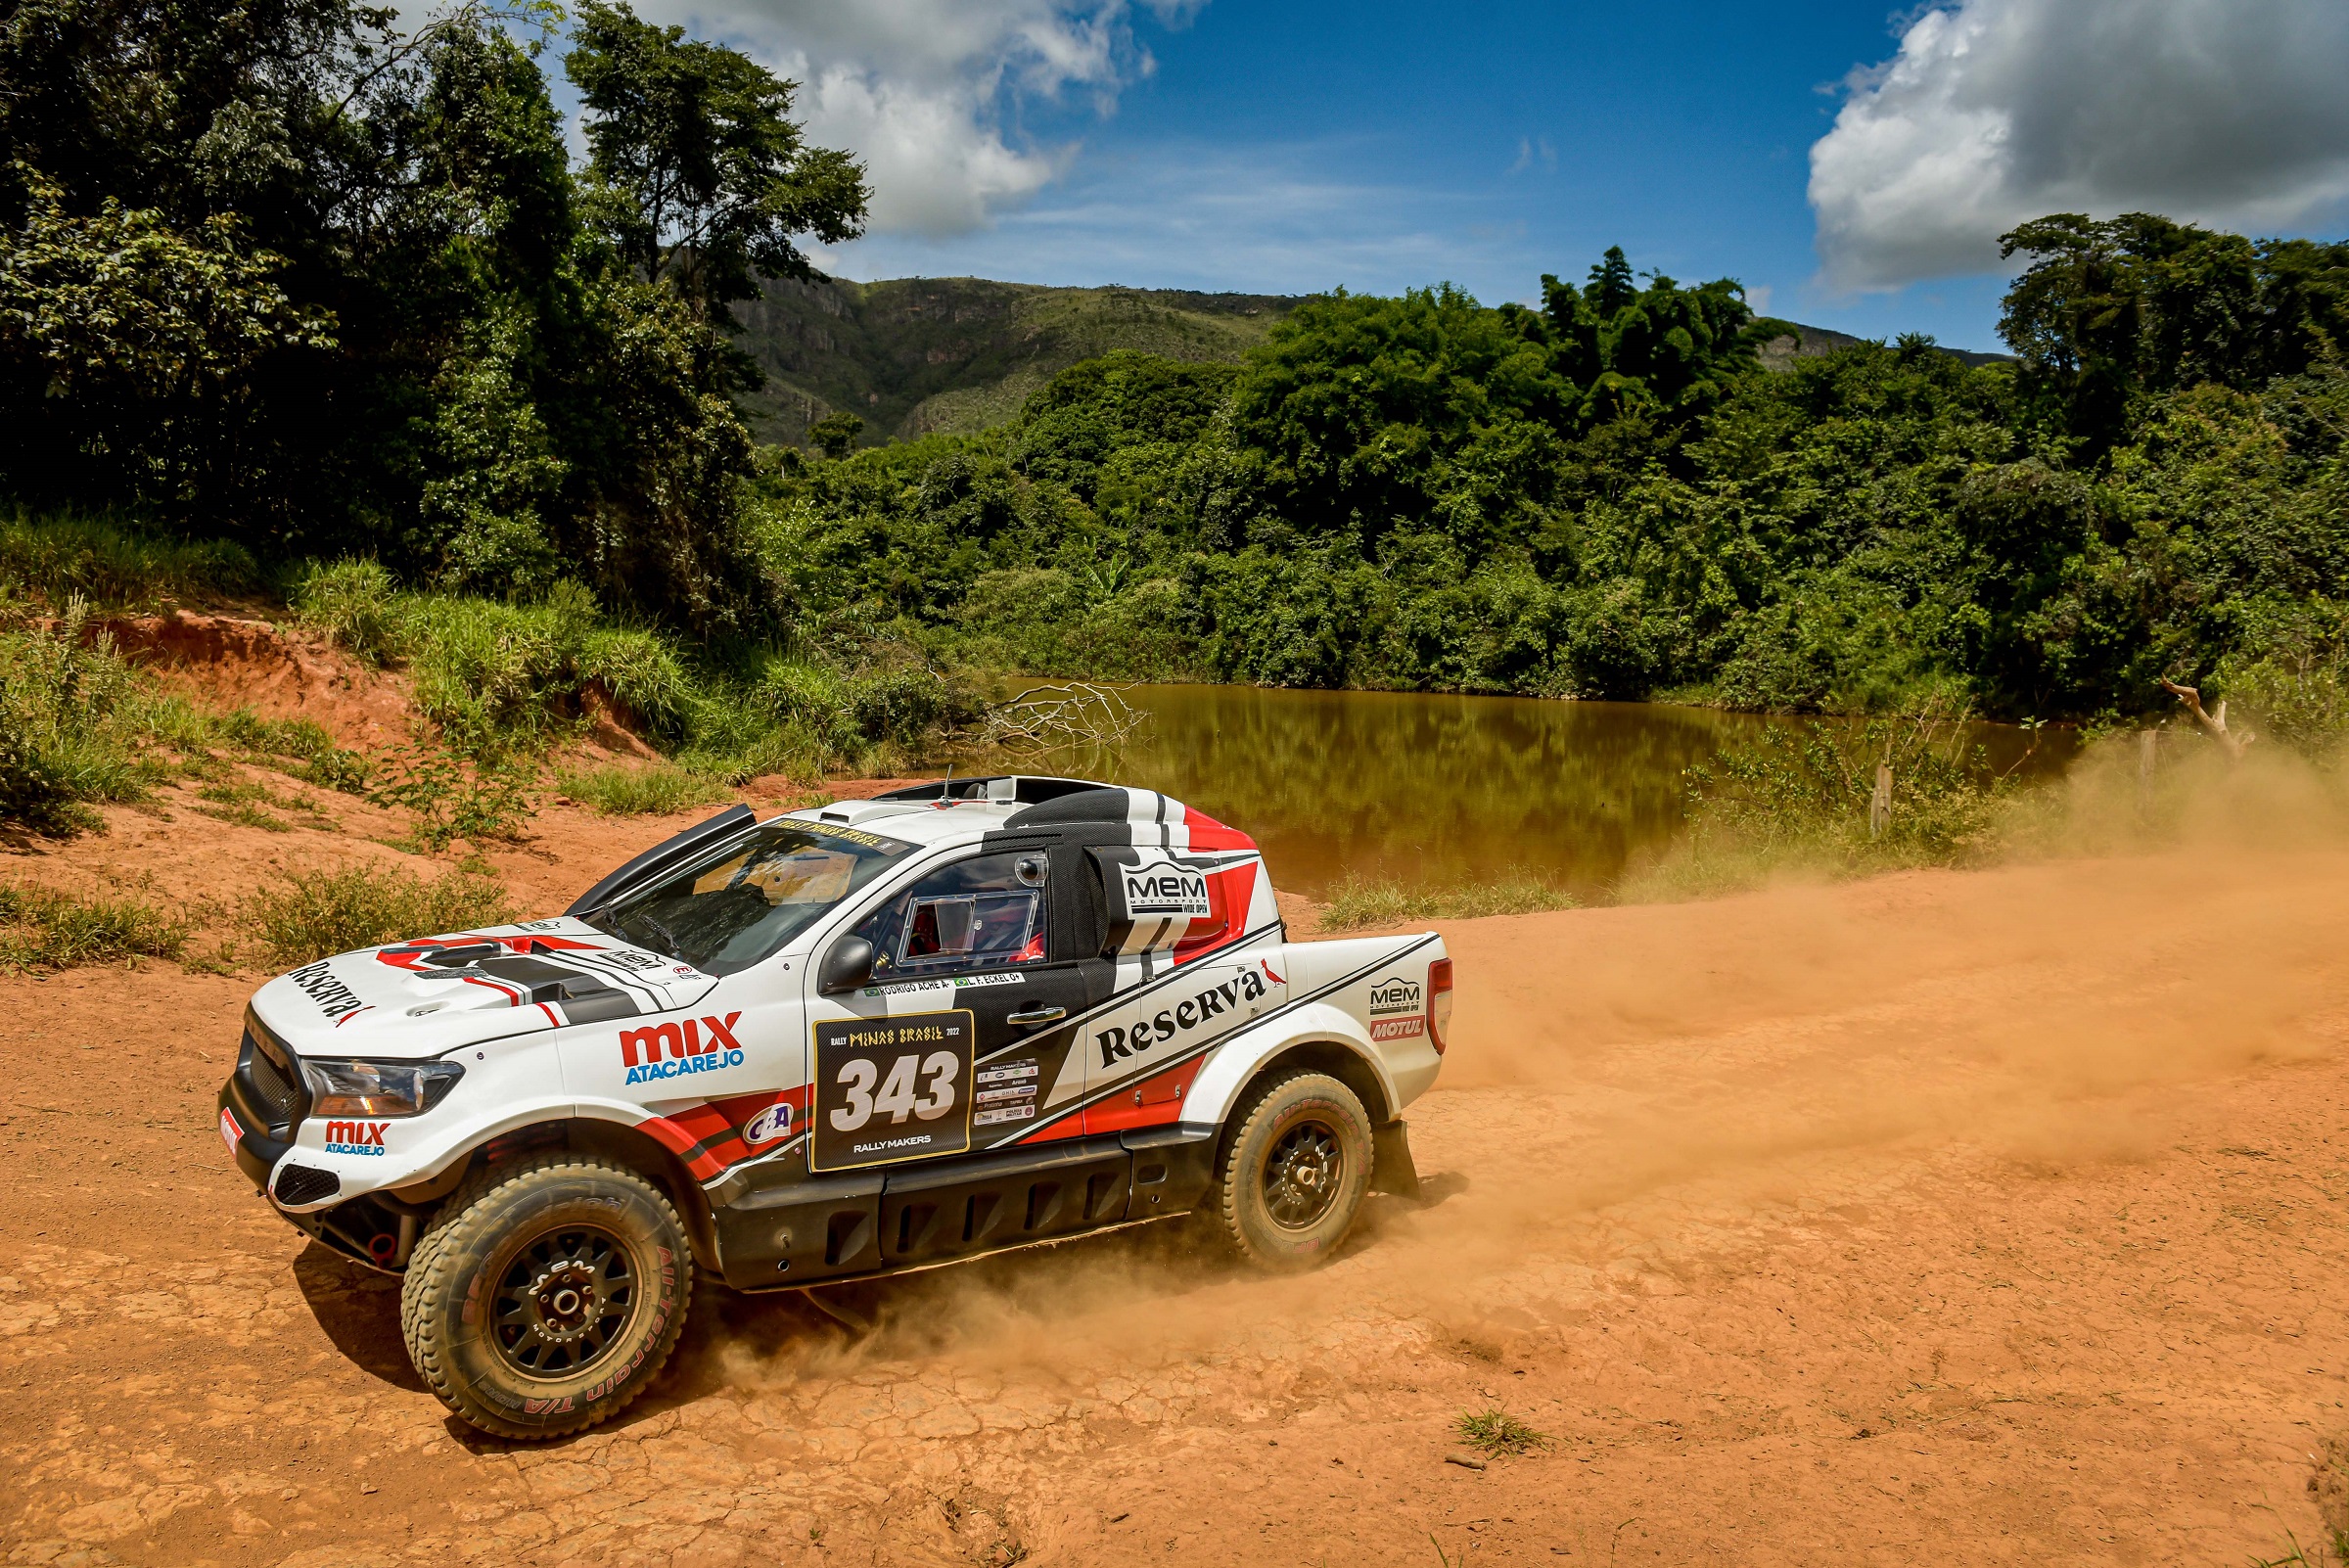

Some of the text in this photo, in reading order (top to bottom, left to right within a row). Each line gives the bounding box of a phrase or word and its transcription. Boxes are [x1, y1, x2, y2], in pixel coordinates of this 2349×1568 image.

[879, 984, 916, 995] RODRIGO
[968, 975, 975, 985] L.
[978, 975, 984, 985] F.
[985, 973, 1009, 984] ECKEL
[831, 1037, 847, 1046] RALLY
[850, 1029, 895, 1047] MINAS
[899, 1026, 944, 1043] BRASIL
[1372, 1020, 1421, 1038] MOTUL
[625, 1050, 744, 1085] ATACAREJO
[830, 1050, 959, 1132] 343
[749, 1105, 790, 1140] CBA
[325, 1143, 385, 1157] ATACAREJO
[586, 1245, 675, 1401] All-Terrain
